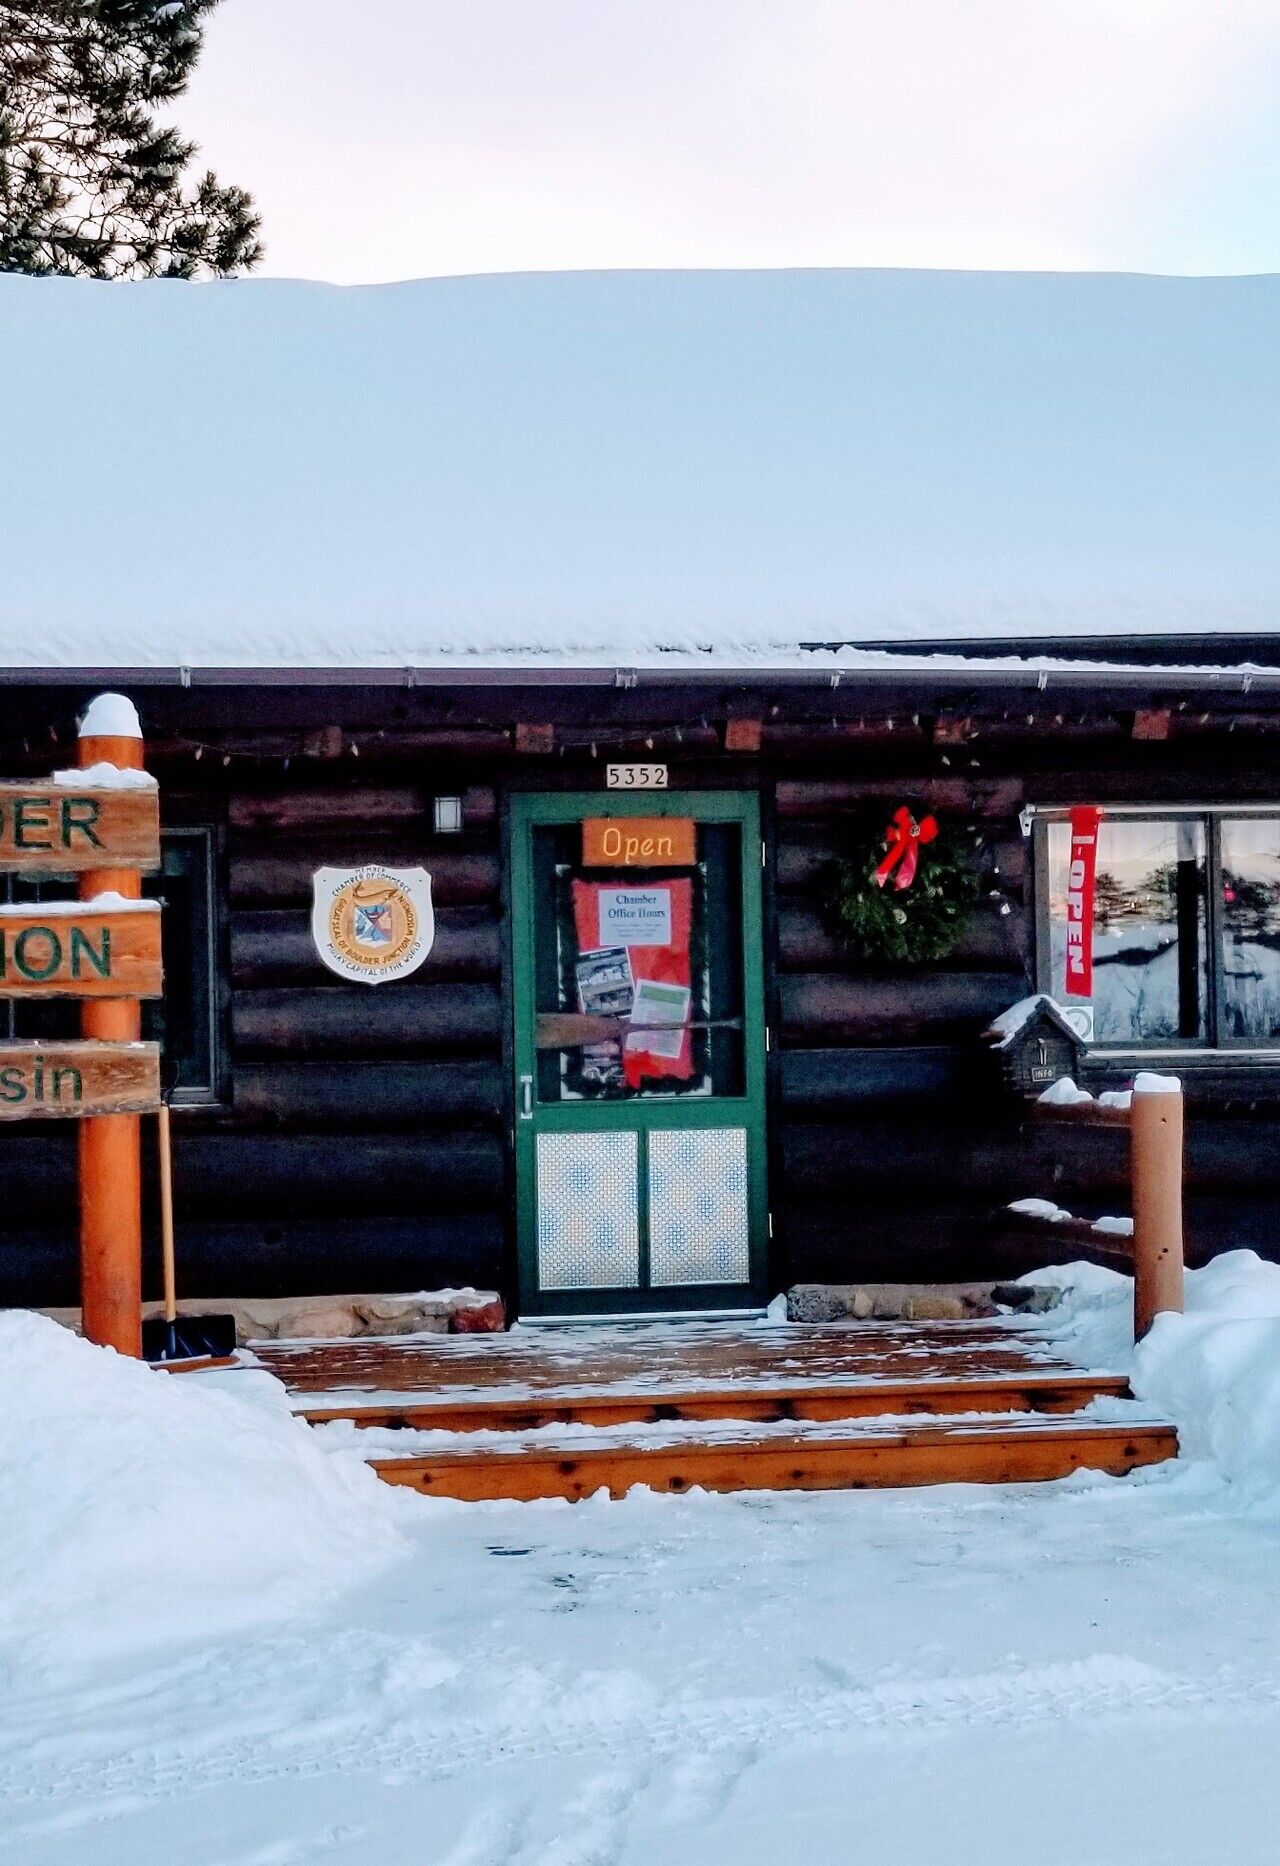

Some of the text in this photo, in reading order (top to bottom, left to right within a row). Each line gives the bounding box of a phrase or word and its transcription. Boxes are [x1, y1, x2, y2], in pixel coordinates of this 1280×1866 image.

[609, 768, 664, 785] 5352
[603, 827, 672, 864] Open
[616, 894, 657, 904] Chamber
[397, 895, 415, 936] WISCONSIN
[608, 908, 666, 918] Office Hours
[1068, 859, 1085, 974] OPEN
[345, 949, 380, 965] BOULDER
[346, 963, 378, 976] CAPITAL
[403, 941, 421, 963] WORLD
[383, 937, 412, 963] JUNCTION
